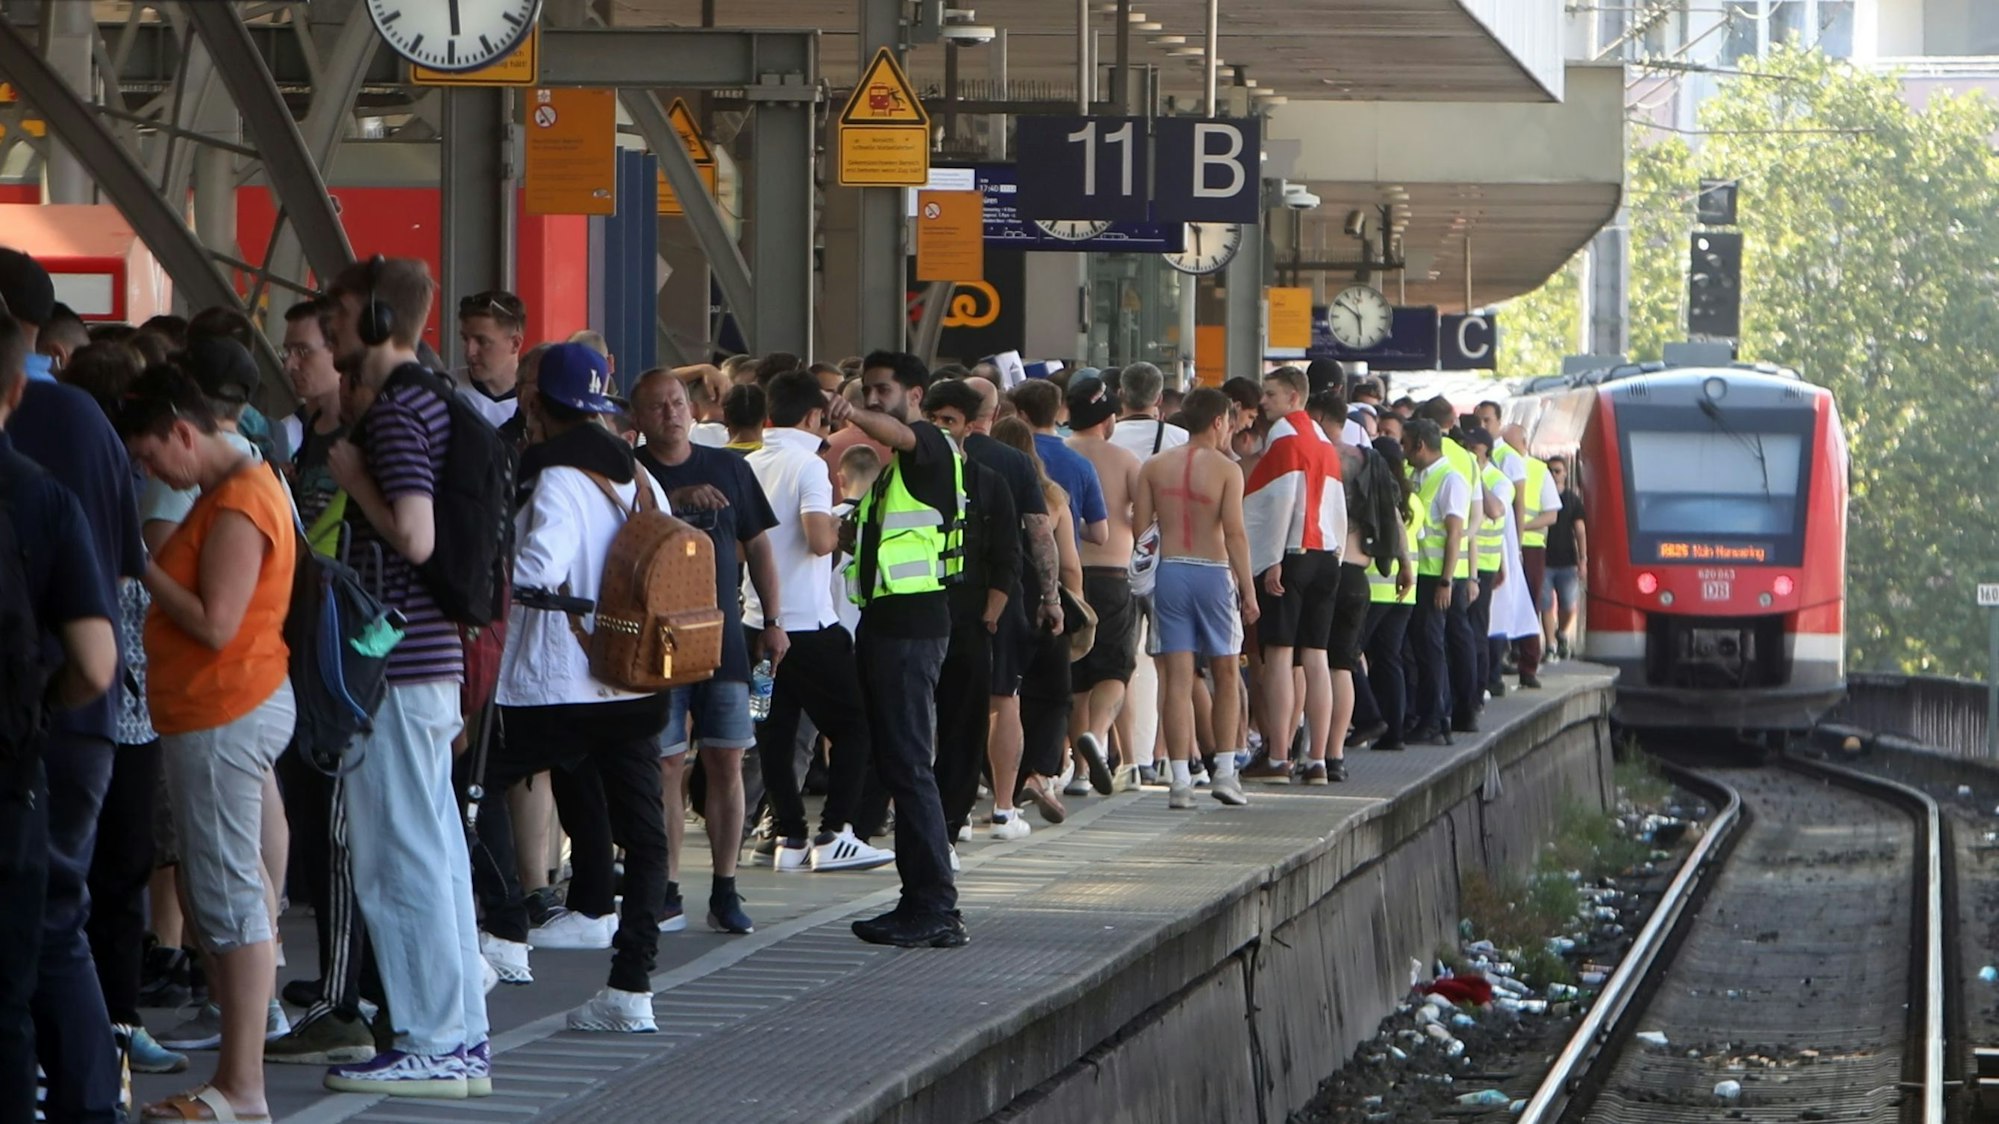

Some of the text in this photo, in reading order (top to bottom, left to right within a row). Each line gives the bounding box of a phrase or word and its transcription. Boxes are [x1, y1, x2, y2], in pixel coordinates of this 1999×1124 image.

[1067, 121, 1133, 196] 11
[1193, 123, 1246, 198] B
[1458, 316, 1490, 359] C
[1706, 582, 1728, 598] DB
